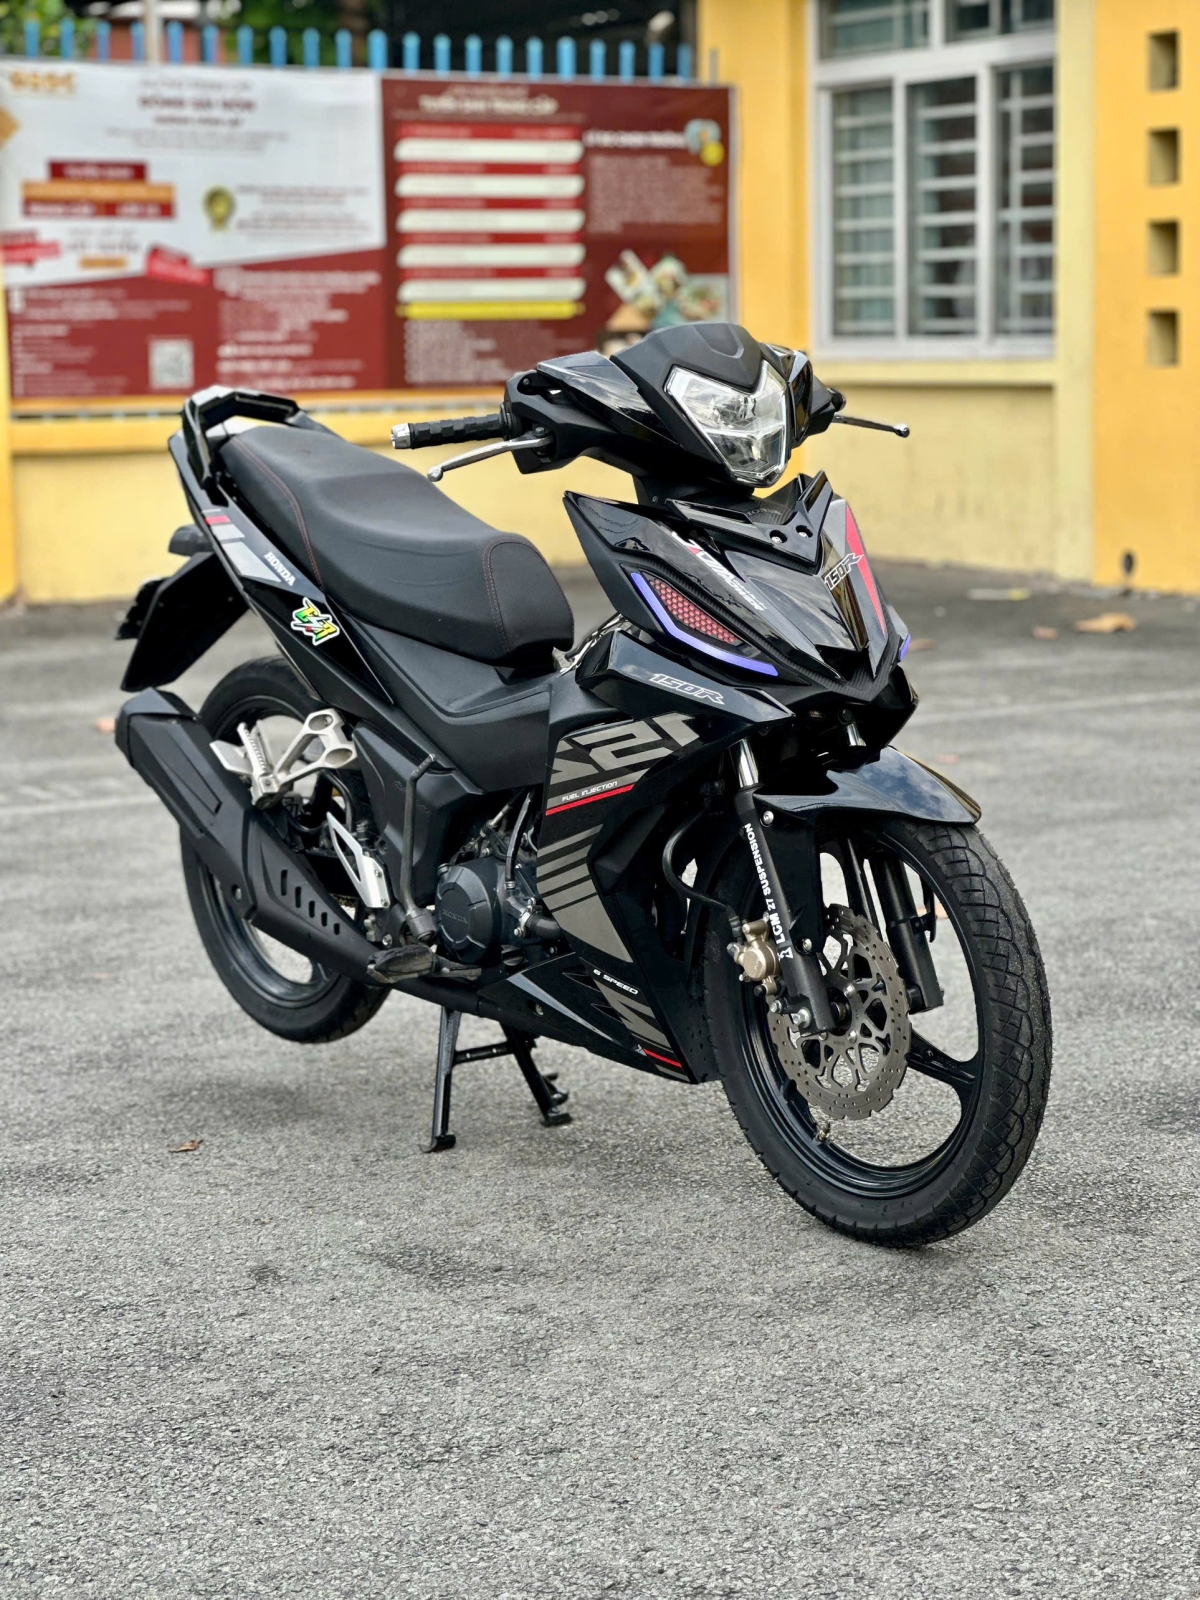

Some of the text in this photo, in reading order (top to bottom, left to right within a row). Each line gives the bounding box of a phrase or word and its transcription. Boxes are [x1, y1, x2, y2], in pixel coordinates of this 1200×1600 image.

[264, 551, 296, 587] HONDA
[824, 552, 865, 591] 150R
[649, 673, 726, 706] 150R
[561, 780, 618, 802] FUEL INJECTION
[744, 822, 786, 945] LCM 27 SUSPENSION
[602, 974, 640, 995] SPEED
